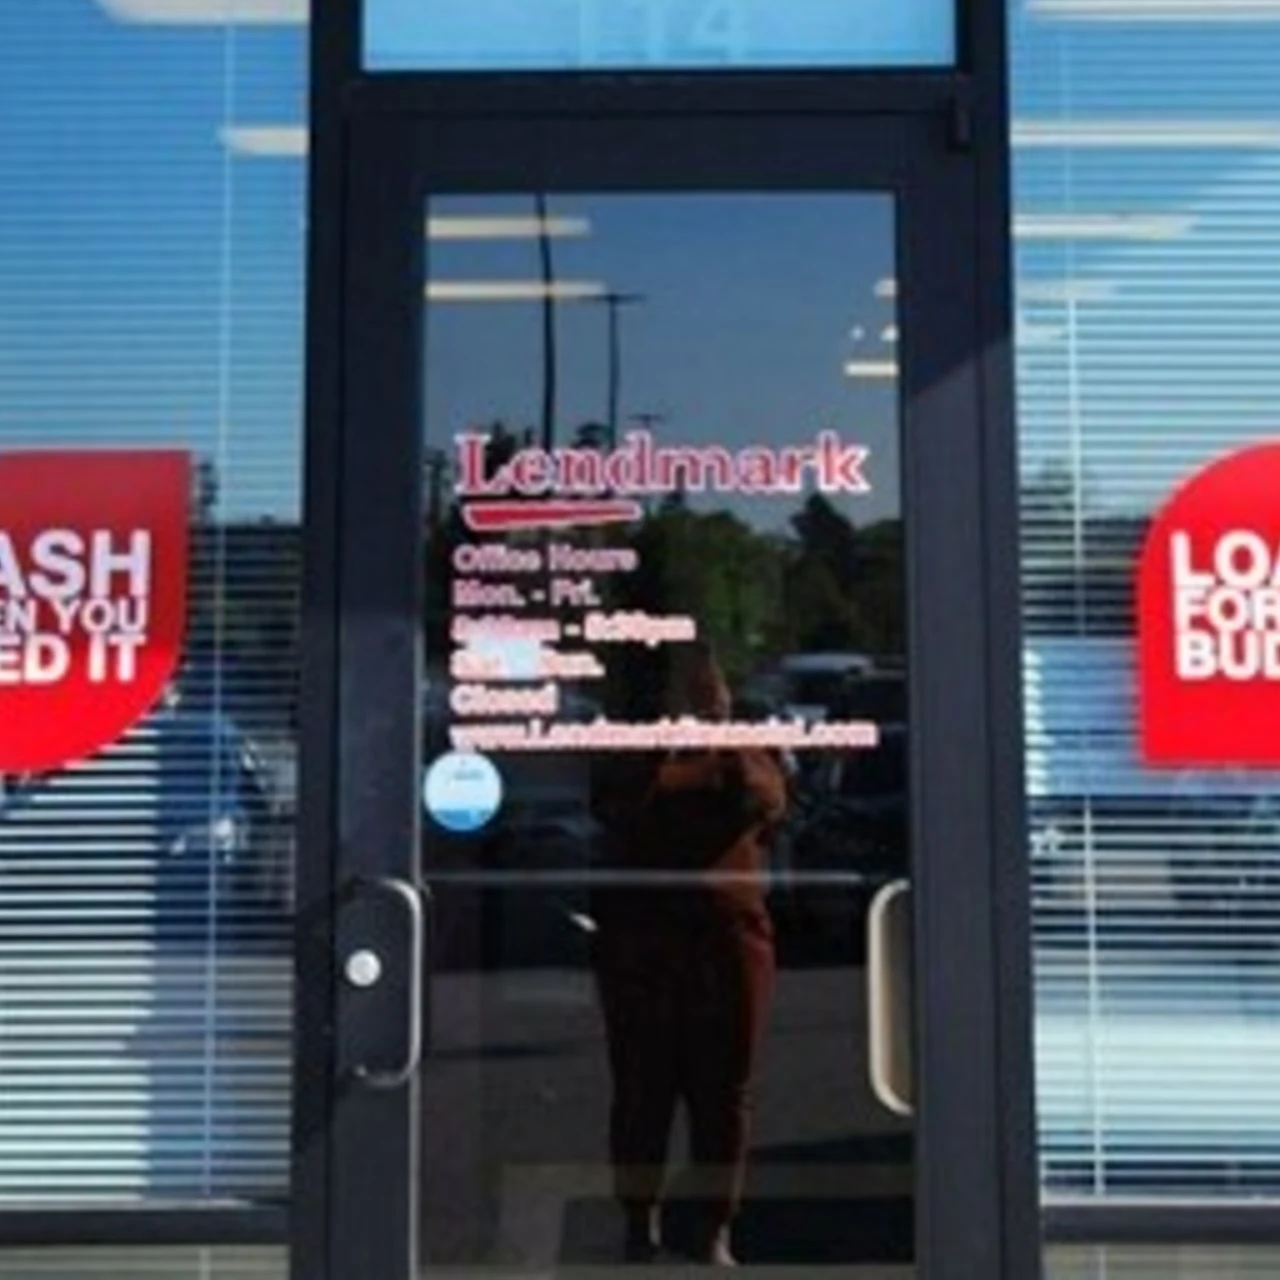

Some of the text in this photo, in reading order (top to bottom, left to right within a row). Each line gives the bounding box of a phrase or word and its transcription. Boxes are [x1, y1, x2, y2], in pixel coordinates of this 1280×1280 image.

[452, 430, 873, 496] Lendmark
[49, 598, 147, 635] YOU
[88, 633, 147, 682] IT
